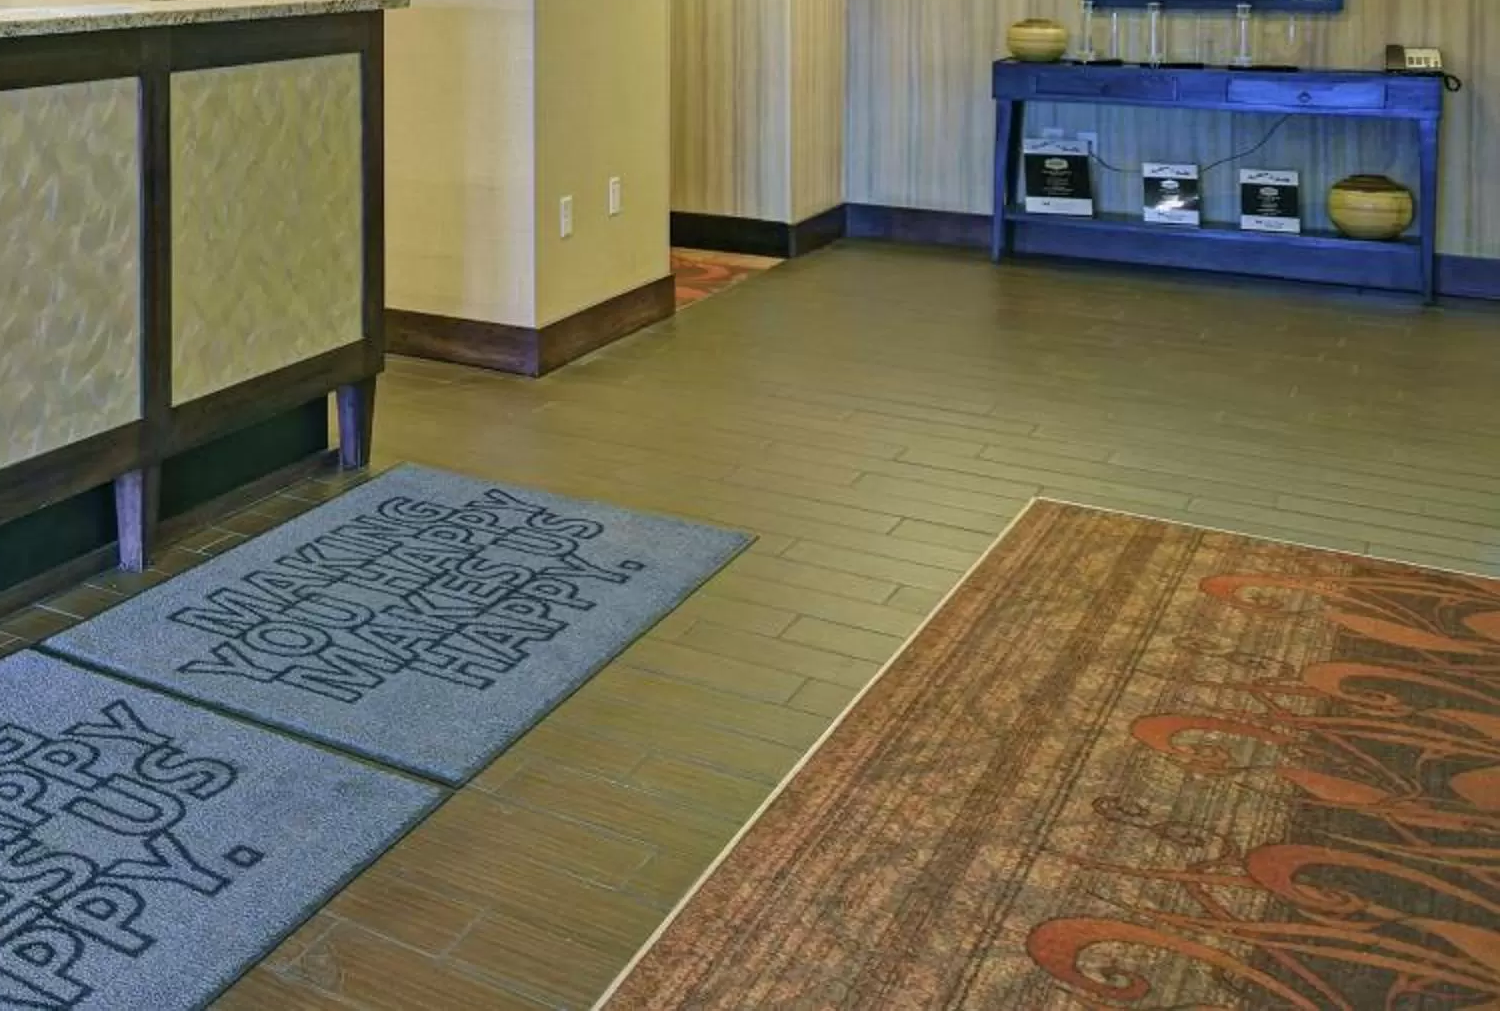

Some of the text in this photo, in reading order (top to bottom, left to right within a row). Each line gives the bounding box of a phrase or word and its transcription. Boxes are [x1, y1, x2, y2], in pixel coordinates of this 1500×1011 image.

[166, 496, 460, 638] MAKING
[177, 488, 546, 683] YOU HAPPY
[274, 510, 605, 703] MAKES US
[406, 552, 646, 690] HAPPY.
[61, 738, 239, 836] US
